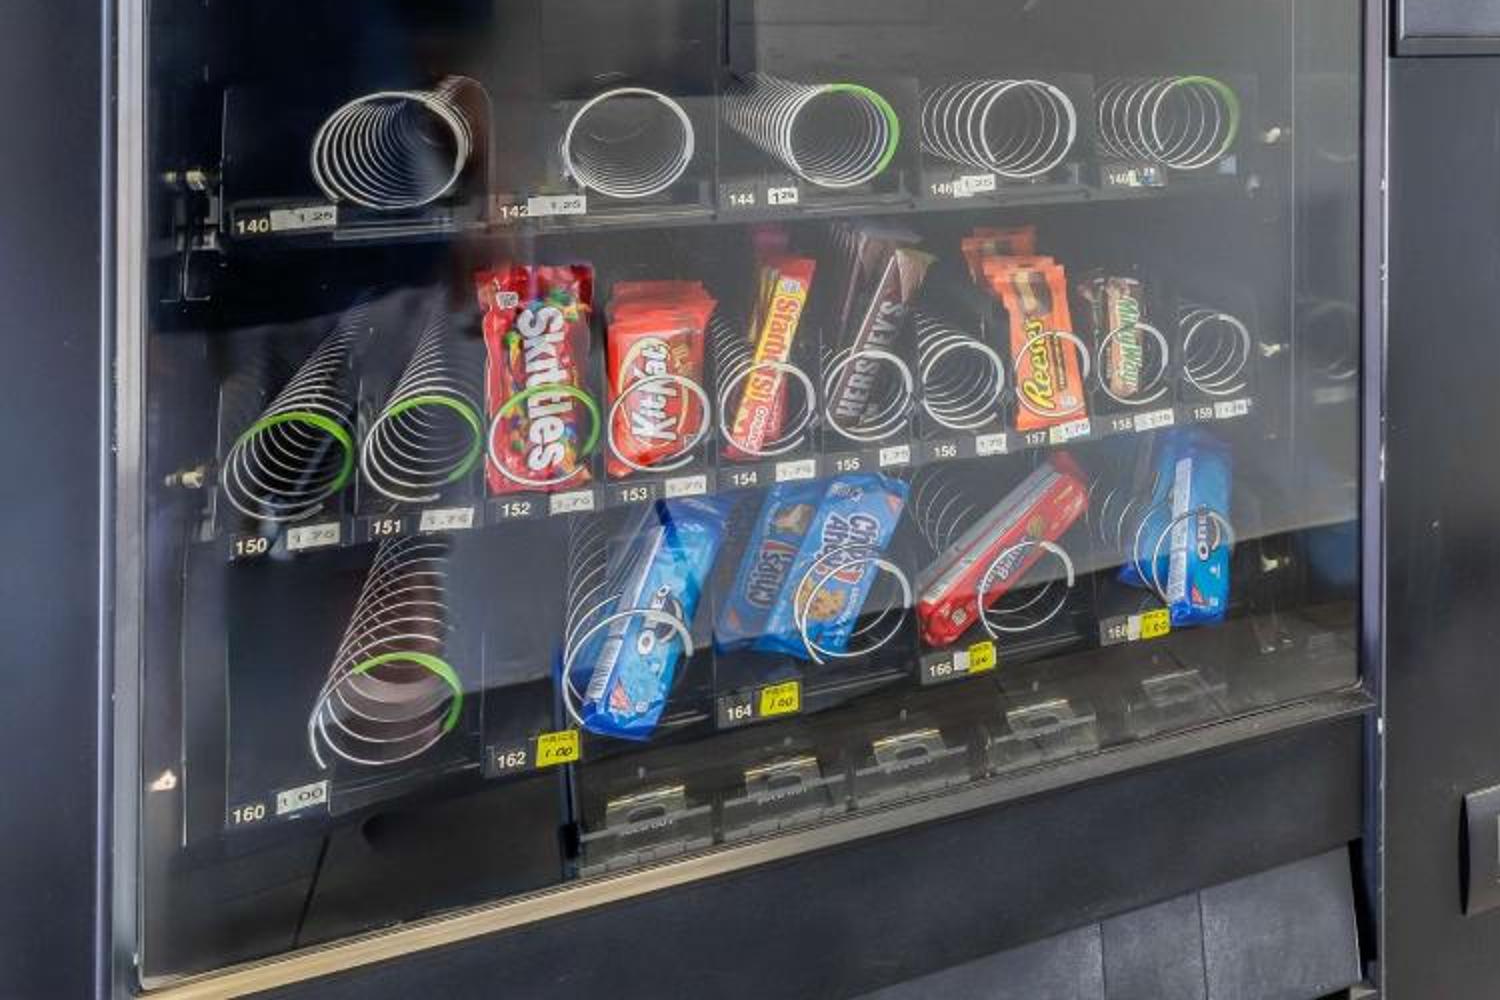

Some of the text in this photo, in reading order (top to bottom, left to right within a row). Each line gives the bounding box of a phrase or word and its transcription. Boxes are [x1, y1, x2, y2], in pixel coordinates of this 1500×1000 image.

[729, 192, 755, 206] 144
[500, 205, 528, 220] 142
[236, 218, 269, 234] 140
[1024, 430, 1047, 446] 157
[933, 444, 958, 459] 156
[731, 471, 758, 487] 154
[621, 487, 649, 502] 153
[501, 501, 531, 517] 152
[371, 518, 402, 536] 151
[234, 537, 268, 556] 150
[726, 703, 753, 720] 164
[497, 751, 528, 769] 162
[232, 804, 266, 825] 160
